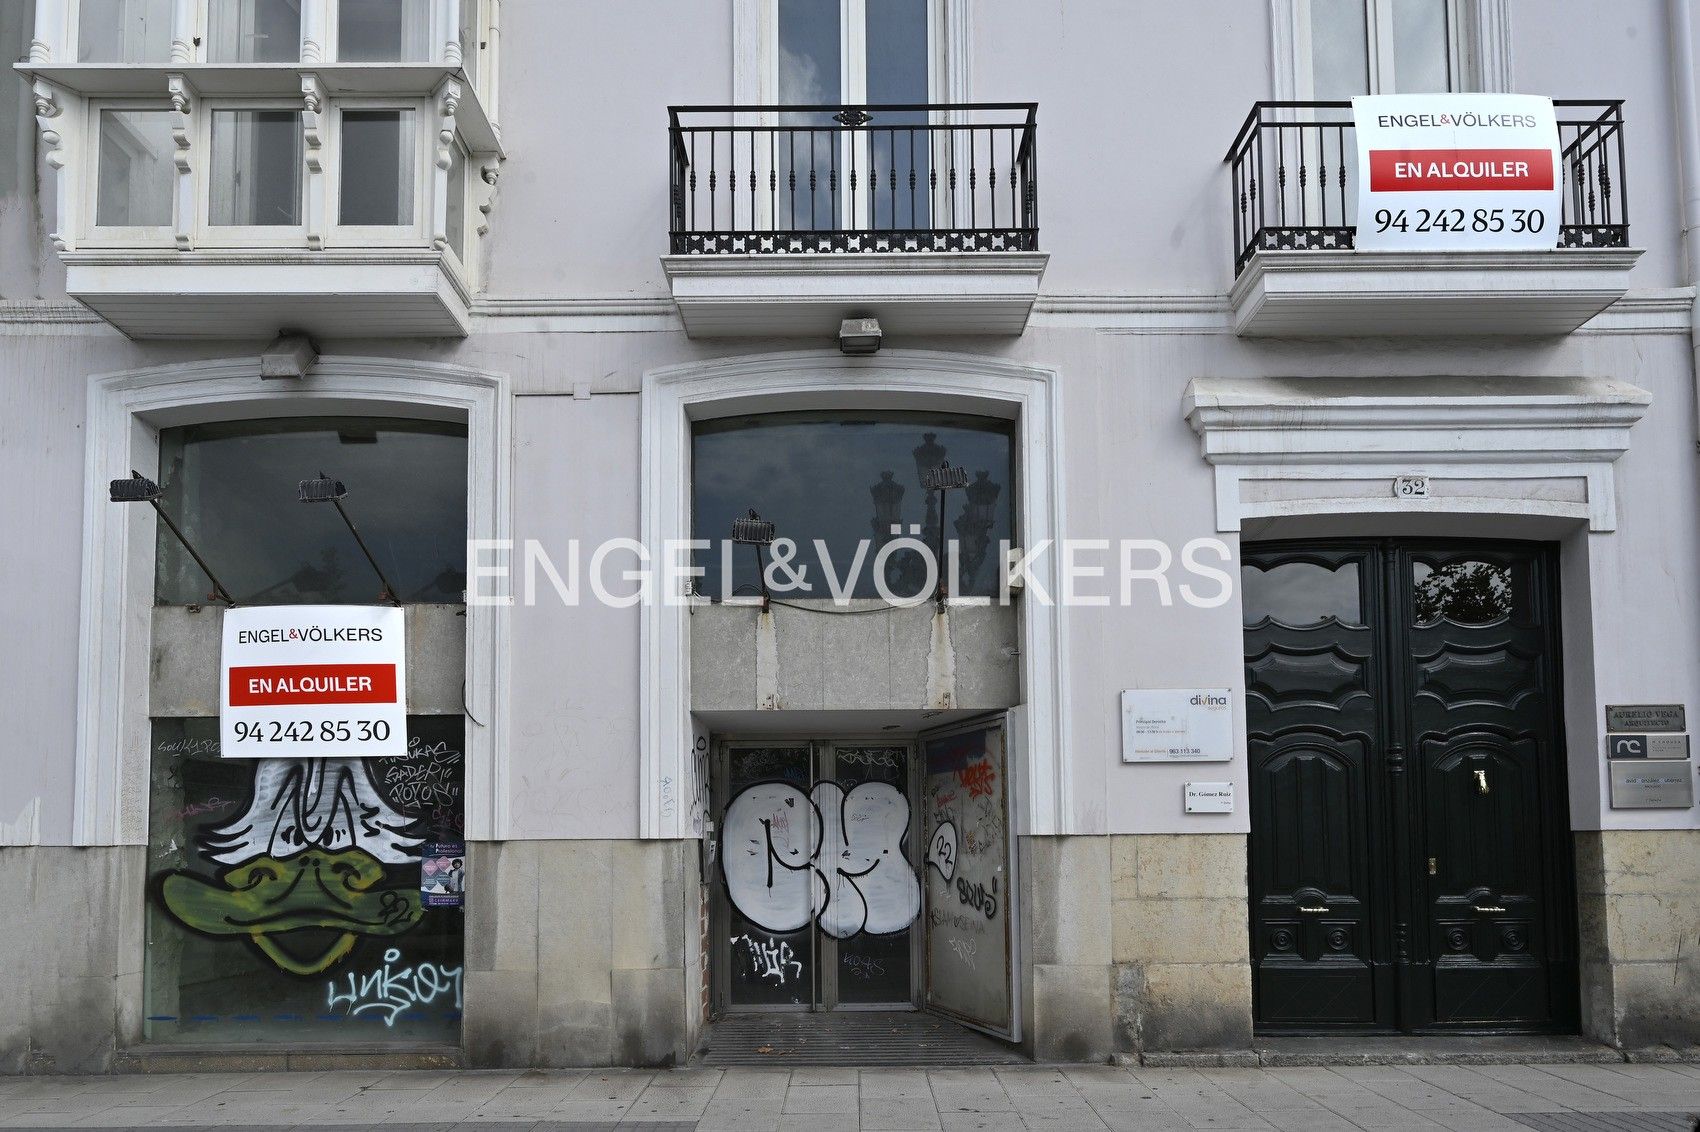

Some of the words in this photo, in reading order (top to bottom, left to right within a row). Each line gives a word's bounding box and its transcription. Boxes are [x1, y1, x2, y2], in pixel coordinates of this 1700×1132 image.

[1377, 111, 1537, 128] ENGEL&VÖLKERS
[1394, 162, 1422, 178] EN
[1426, 161, 1529, 178] ALQUILER
[1374, 208, 1410, 233] 94
[1415, 208, 1466, 233] 242
[1471, 208, 1505, 233] 85
[1510, 208, 1546, 233] 30
[1402, 479, 1425, 495] 32
[238, 625, 383, 644] ENGEL&VÖLKERS
[248, 678, 273, 694] EN
[276, 676, 372, 693] ALQUILER
[1190, 694, 1227, 706] divina
[1655, 710, 1680, 718] VEGA
[233, 721, 264, 742] 94
[269, 720, 315, 742] 242
[319, 720, 351, 742] 85
[357, 719, 391, 741] 30
